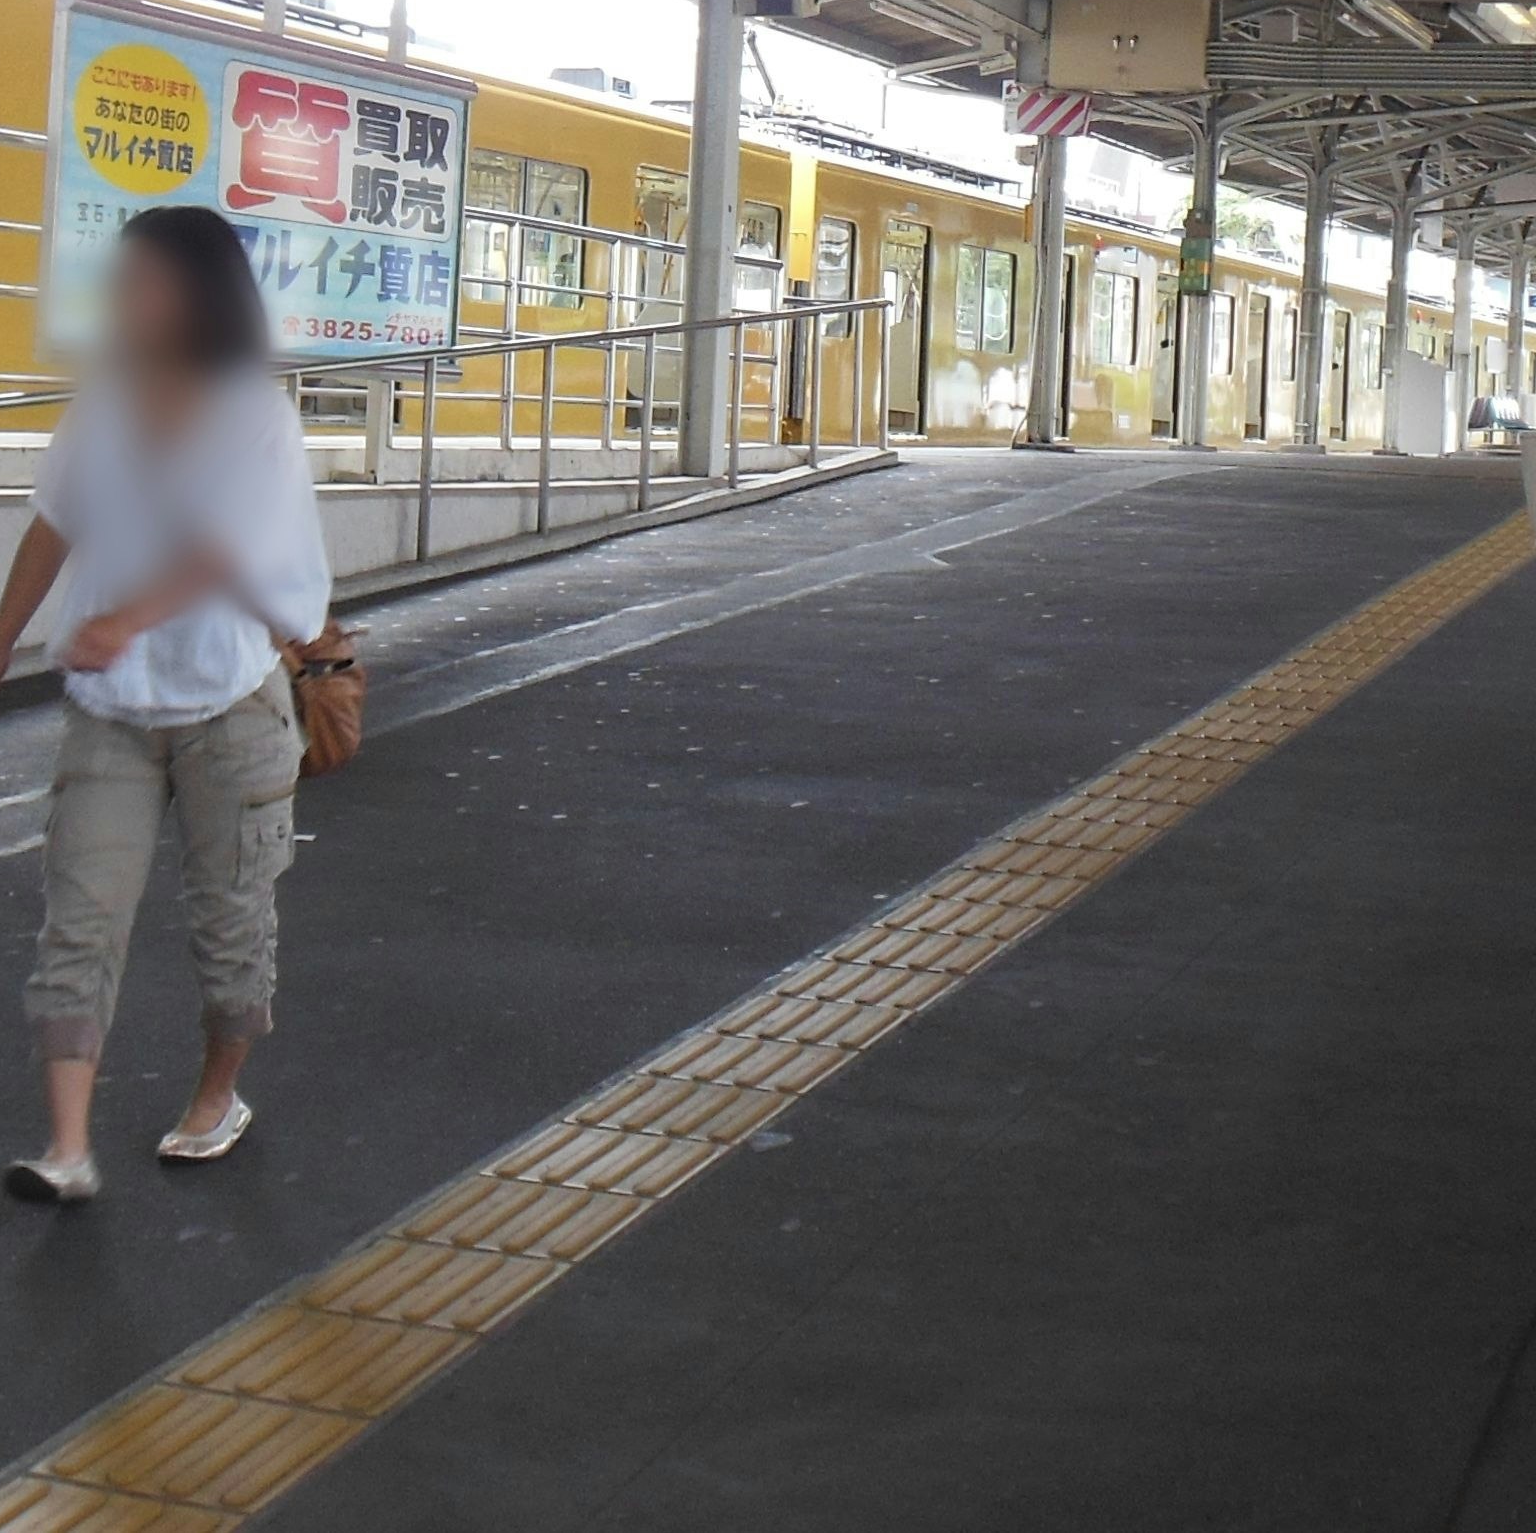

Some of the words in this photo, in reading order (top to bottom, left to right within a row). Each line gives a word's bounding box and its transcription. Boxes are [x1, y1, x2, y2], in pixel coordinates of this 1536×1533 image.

[94, 96, 190, 133] あなたの街の
[353, 98, 450, 172] 買取
[83, 125, 194, 174] マルイチ質店
[225, 69, 351, 225] 質
[349, 163, 447, 235] 販売
[305, 317, 444, 347] 3825-7801
